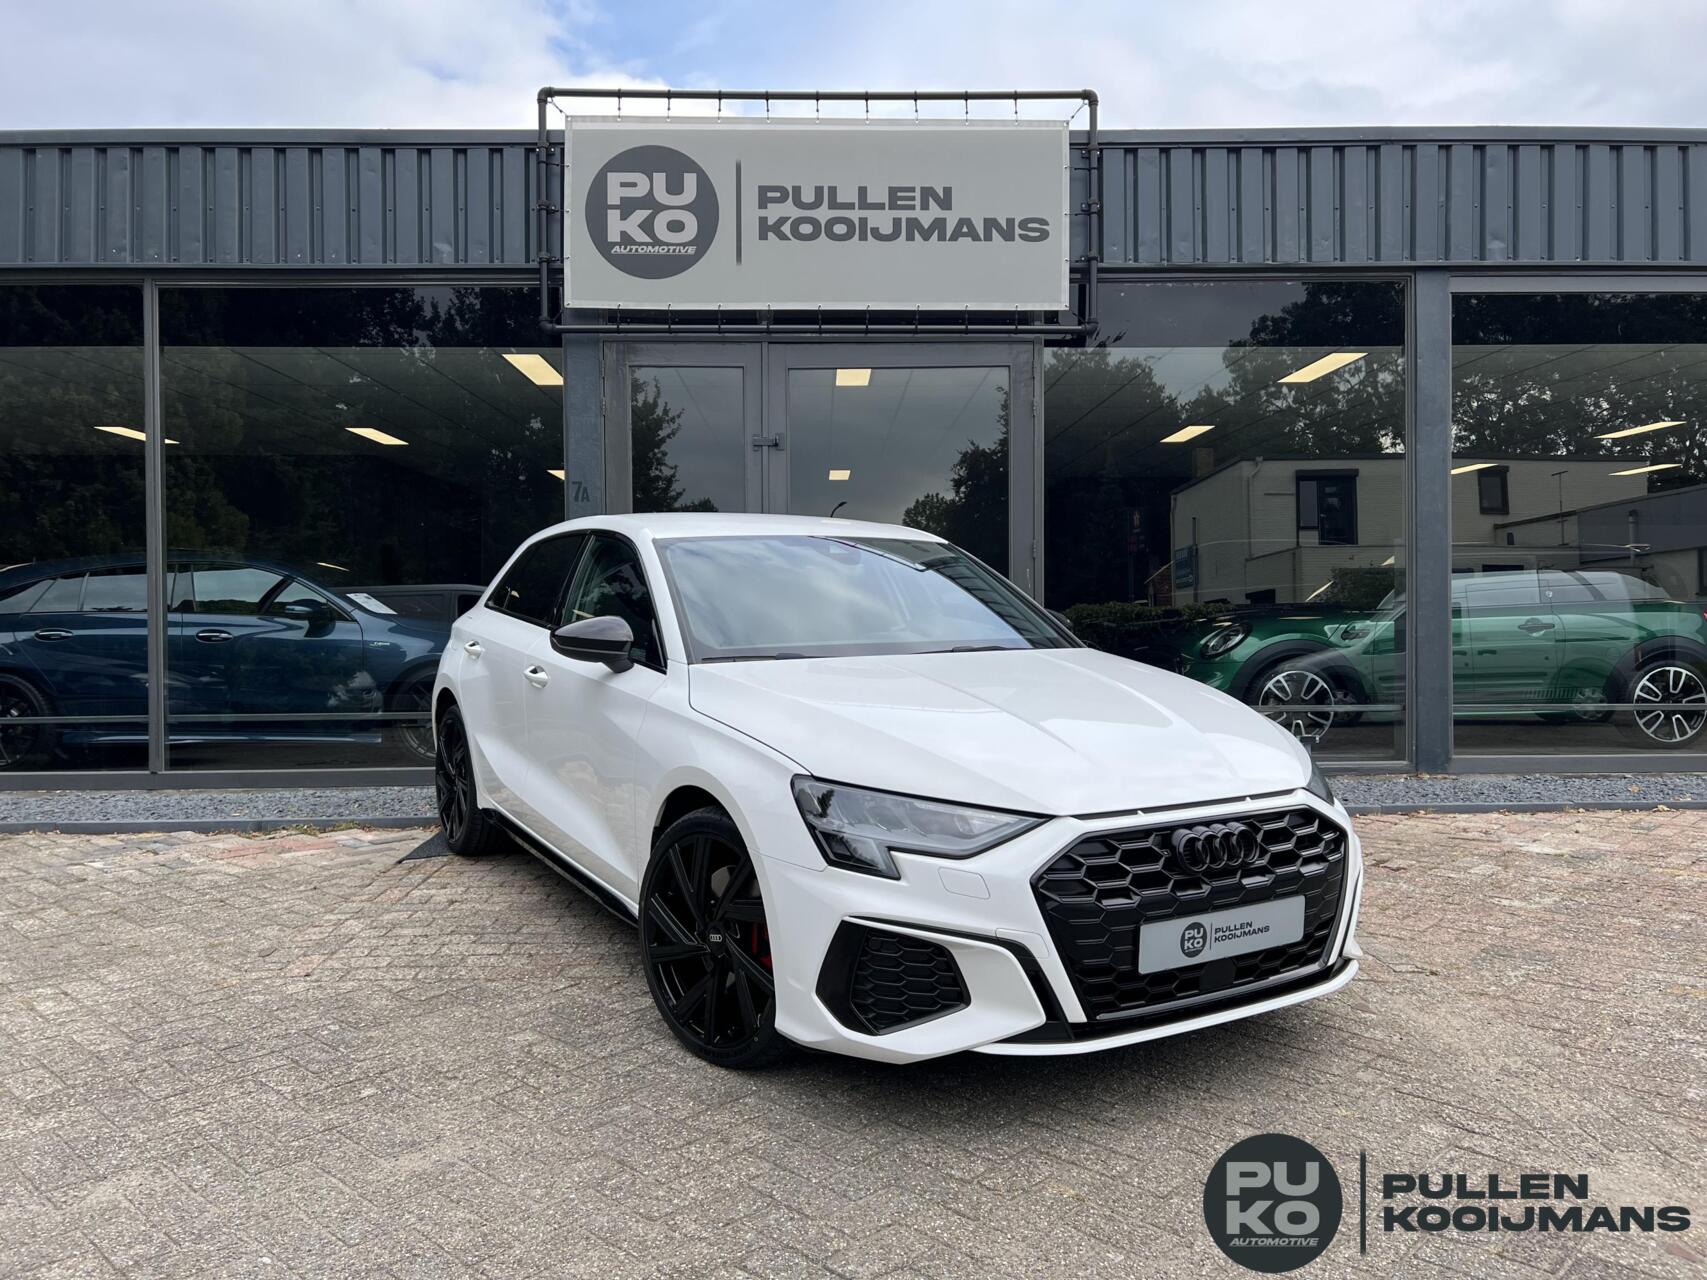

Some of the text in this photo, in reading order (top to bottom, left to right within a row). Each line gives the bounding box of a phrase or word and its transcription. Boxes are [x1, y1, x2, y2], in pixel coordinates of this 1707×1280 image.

[607, 172, 697, 206] PU
[757, 185, 953, 211] PULLEN
[607, 209, 698, 244] KO
[757, 216, 1050, 243] KOOIJMANS
[610, 245, 697, 255] AUTOMOTIVE
[571, 480, 590, 502] 7A
[1184, 927, 1204, 940] PU
[1213, 925, 1270, 943] KOOIJMANS
[1214, 921, 1253, 935] PULLEN
[1183, 938, 1204, 950] KO
